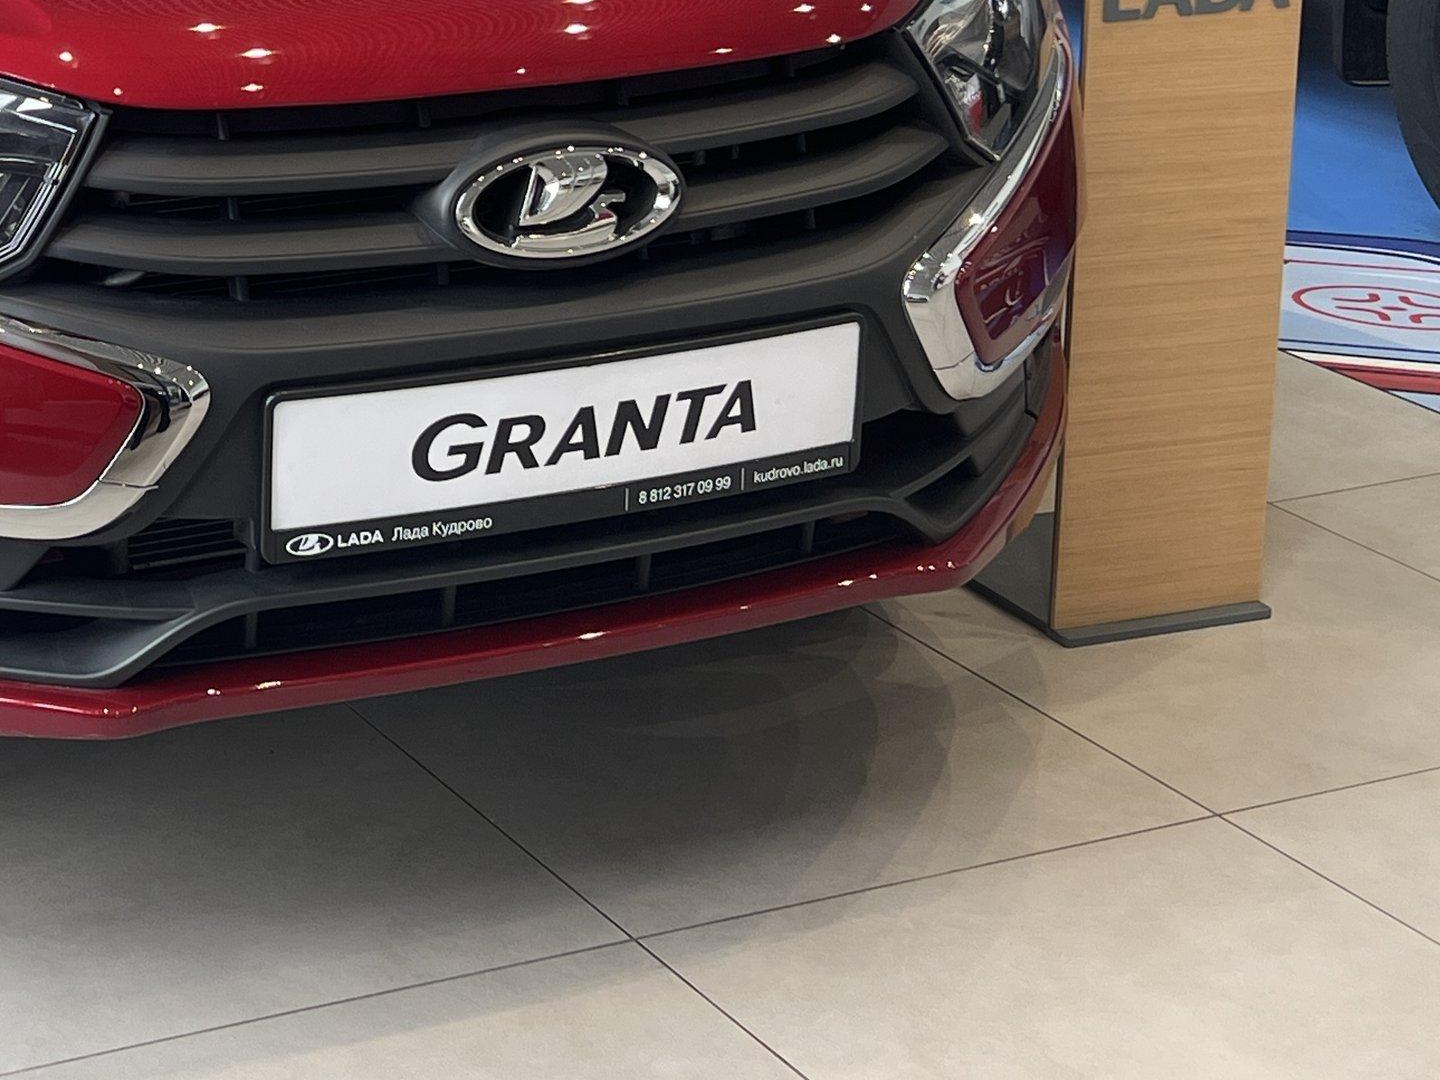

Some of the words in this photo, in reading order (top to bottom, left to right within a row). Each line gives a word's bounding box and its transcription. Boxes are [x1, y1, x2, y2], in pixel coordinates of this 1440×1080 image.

[411, 379, 757, 483] GRANTA
[753, 456, 844, 484] kudrovo.lada.ru
[638, 491, 647, 504] 8
[649, 486, 672, 503] 812
[673, 482, 695, 499] 317
[697, 479, 714, 494] 09
[715, 475, 732, 491] 99
[337, 529, 384, 548] LADA
[391, 526, 430, 542] Лада
[432, 517, 493, 537] Кудрово
